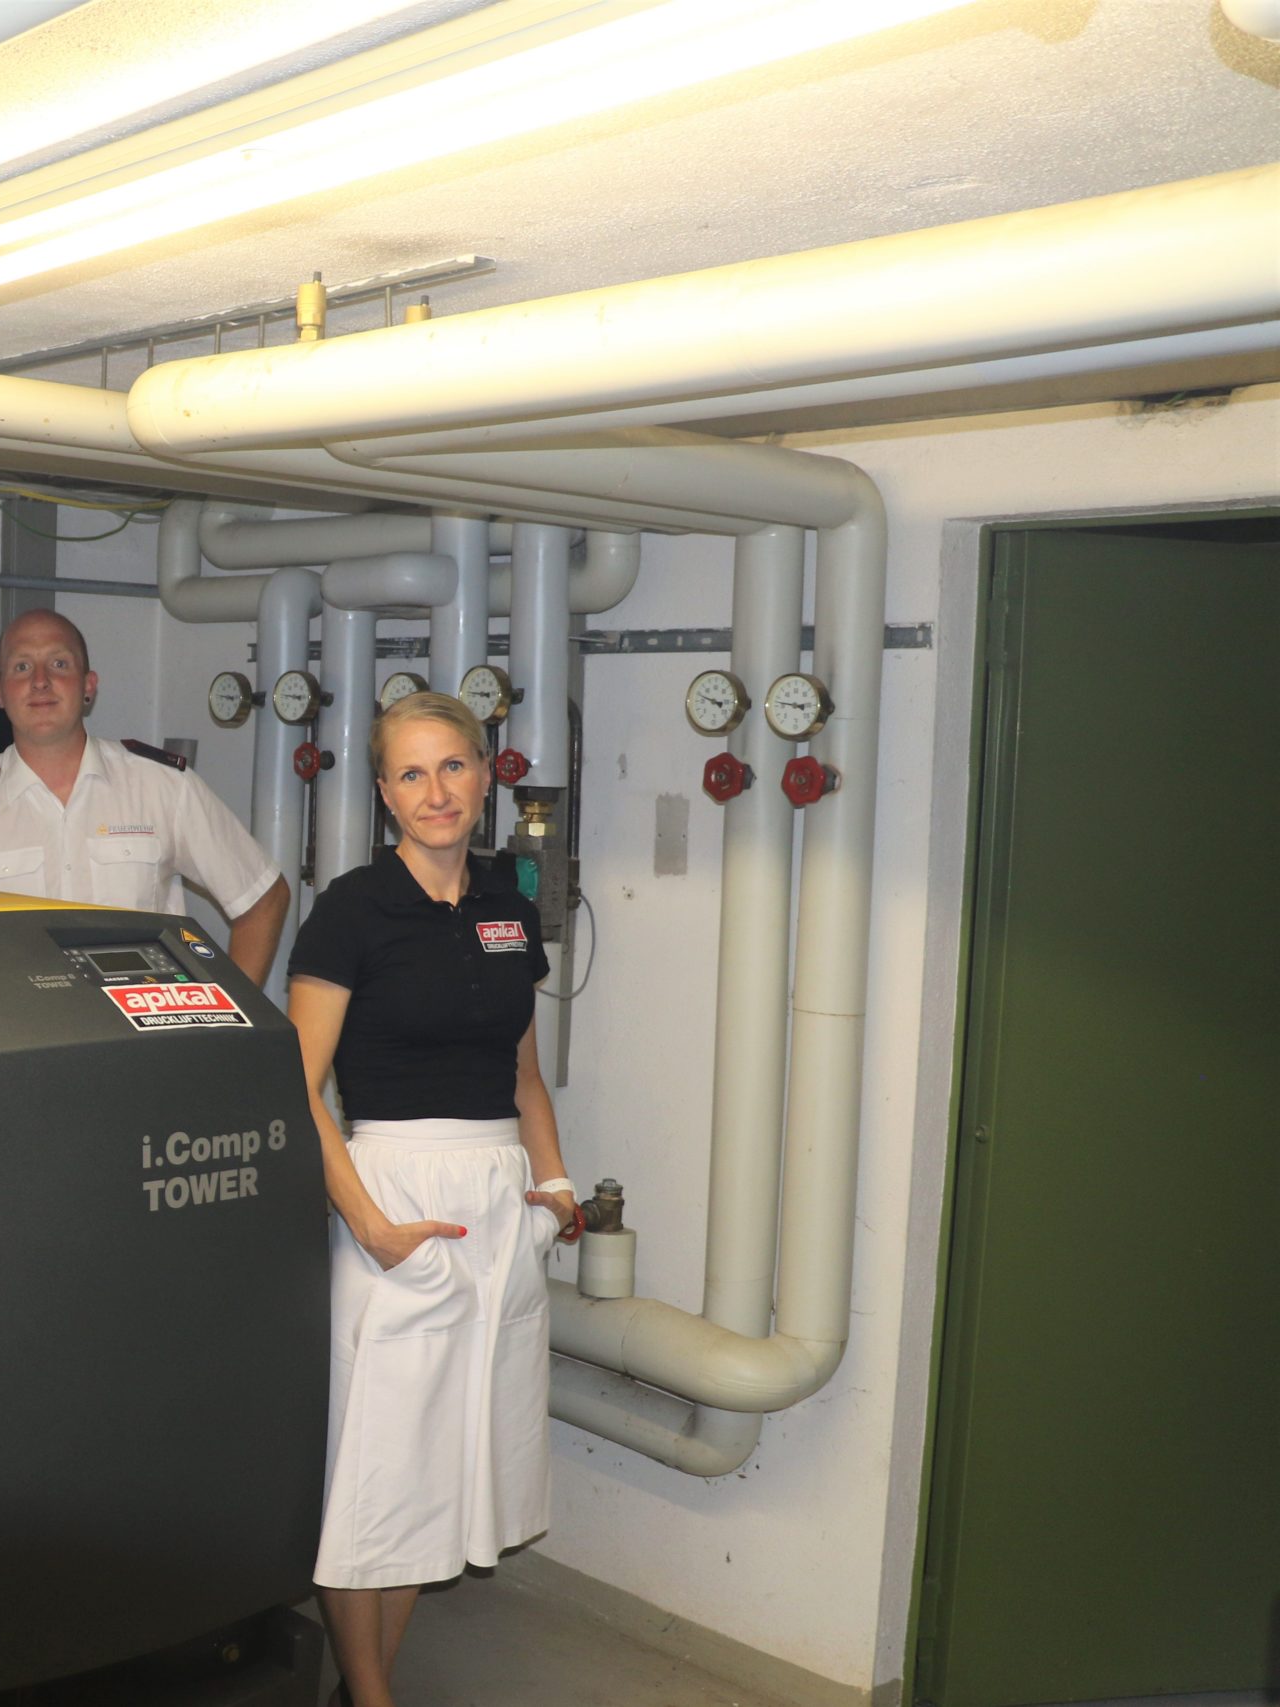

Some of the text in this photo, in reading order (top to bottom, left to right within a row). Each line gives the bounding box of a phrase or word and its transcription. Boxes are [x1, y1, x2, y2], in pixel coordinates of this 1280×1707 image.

[482, 922, 519, 941] apikal
[125, 984, 218, 1014] apikal
[139, 1013, 239, 1026] DRUCKLUFTTECHNIK
[142, 1119, 286, 1169] i.Comp 8
[142, 1166, 259, 1212] TOWER
